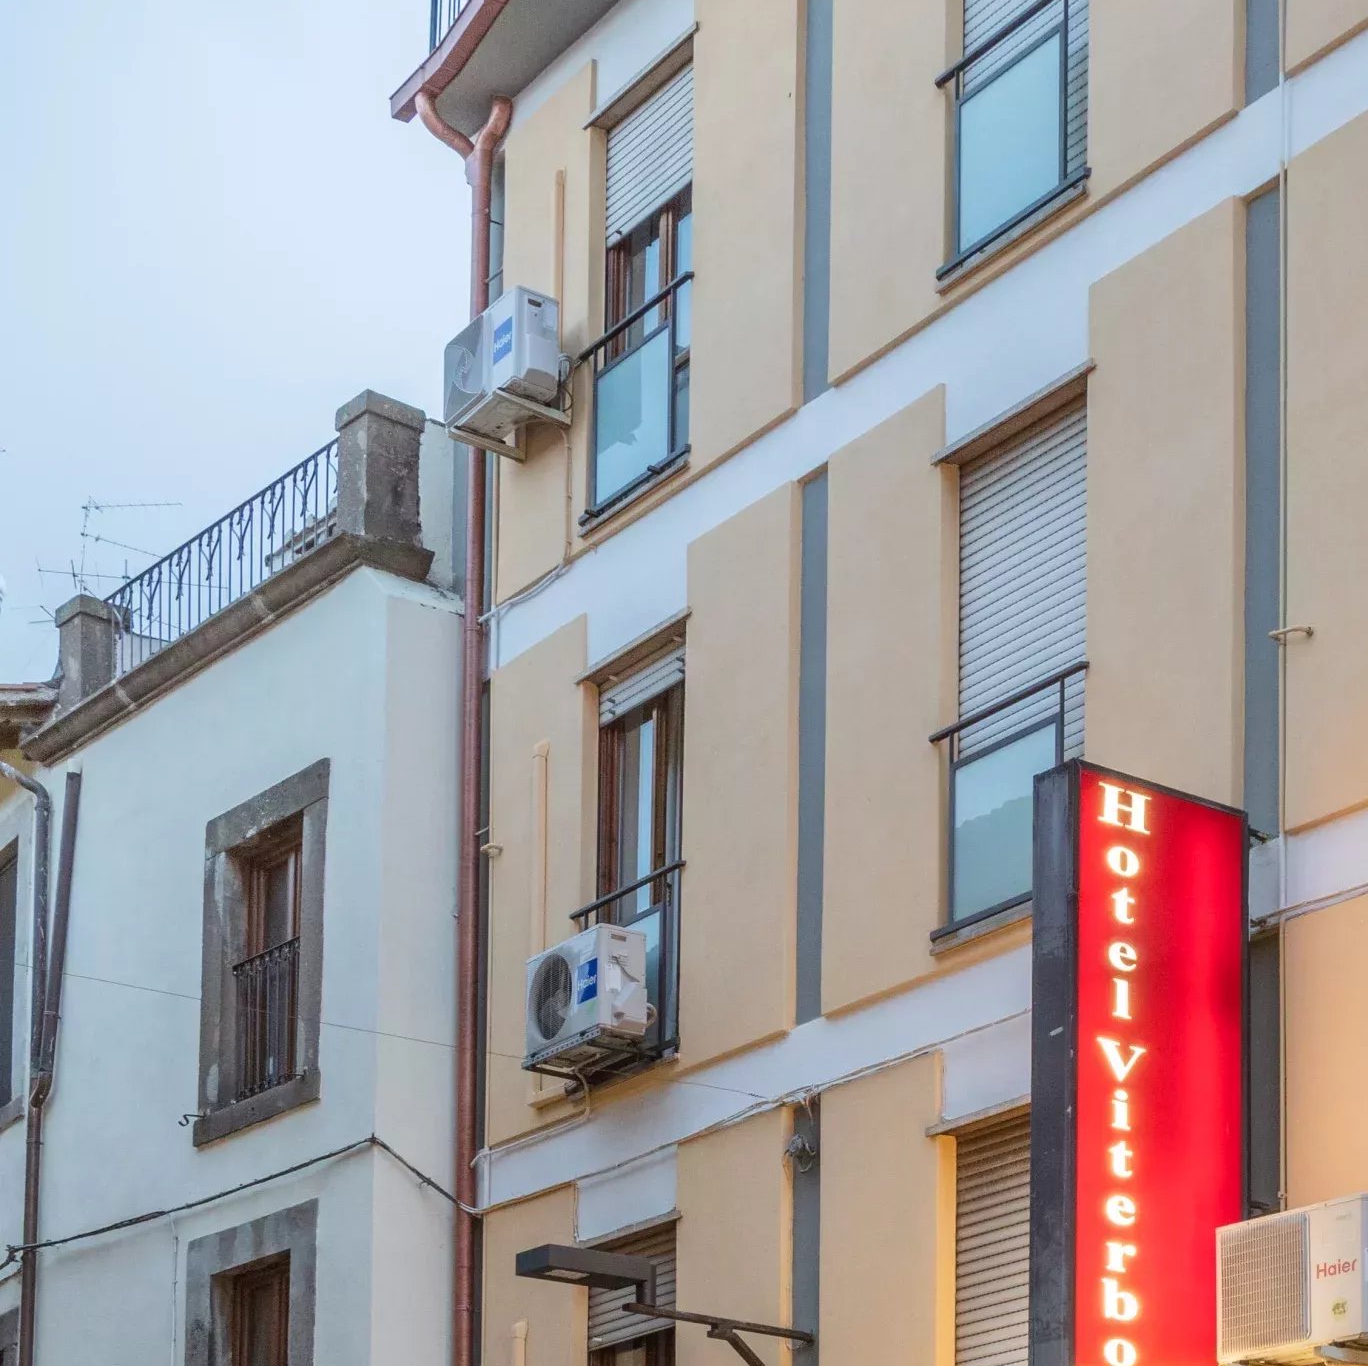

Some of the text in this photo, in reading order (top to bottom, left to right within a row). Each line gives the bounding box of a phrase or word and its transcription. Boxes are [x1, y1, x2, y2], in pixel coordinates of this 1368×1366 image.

[1097, 781, 1153, 1019] Hotel
[577, 973, 597, 991] Haier
[1316, 1259, 1358, 1279] Haier
